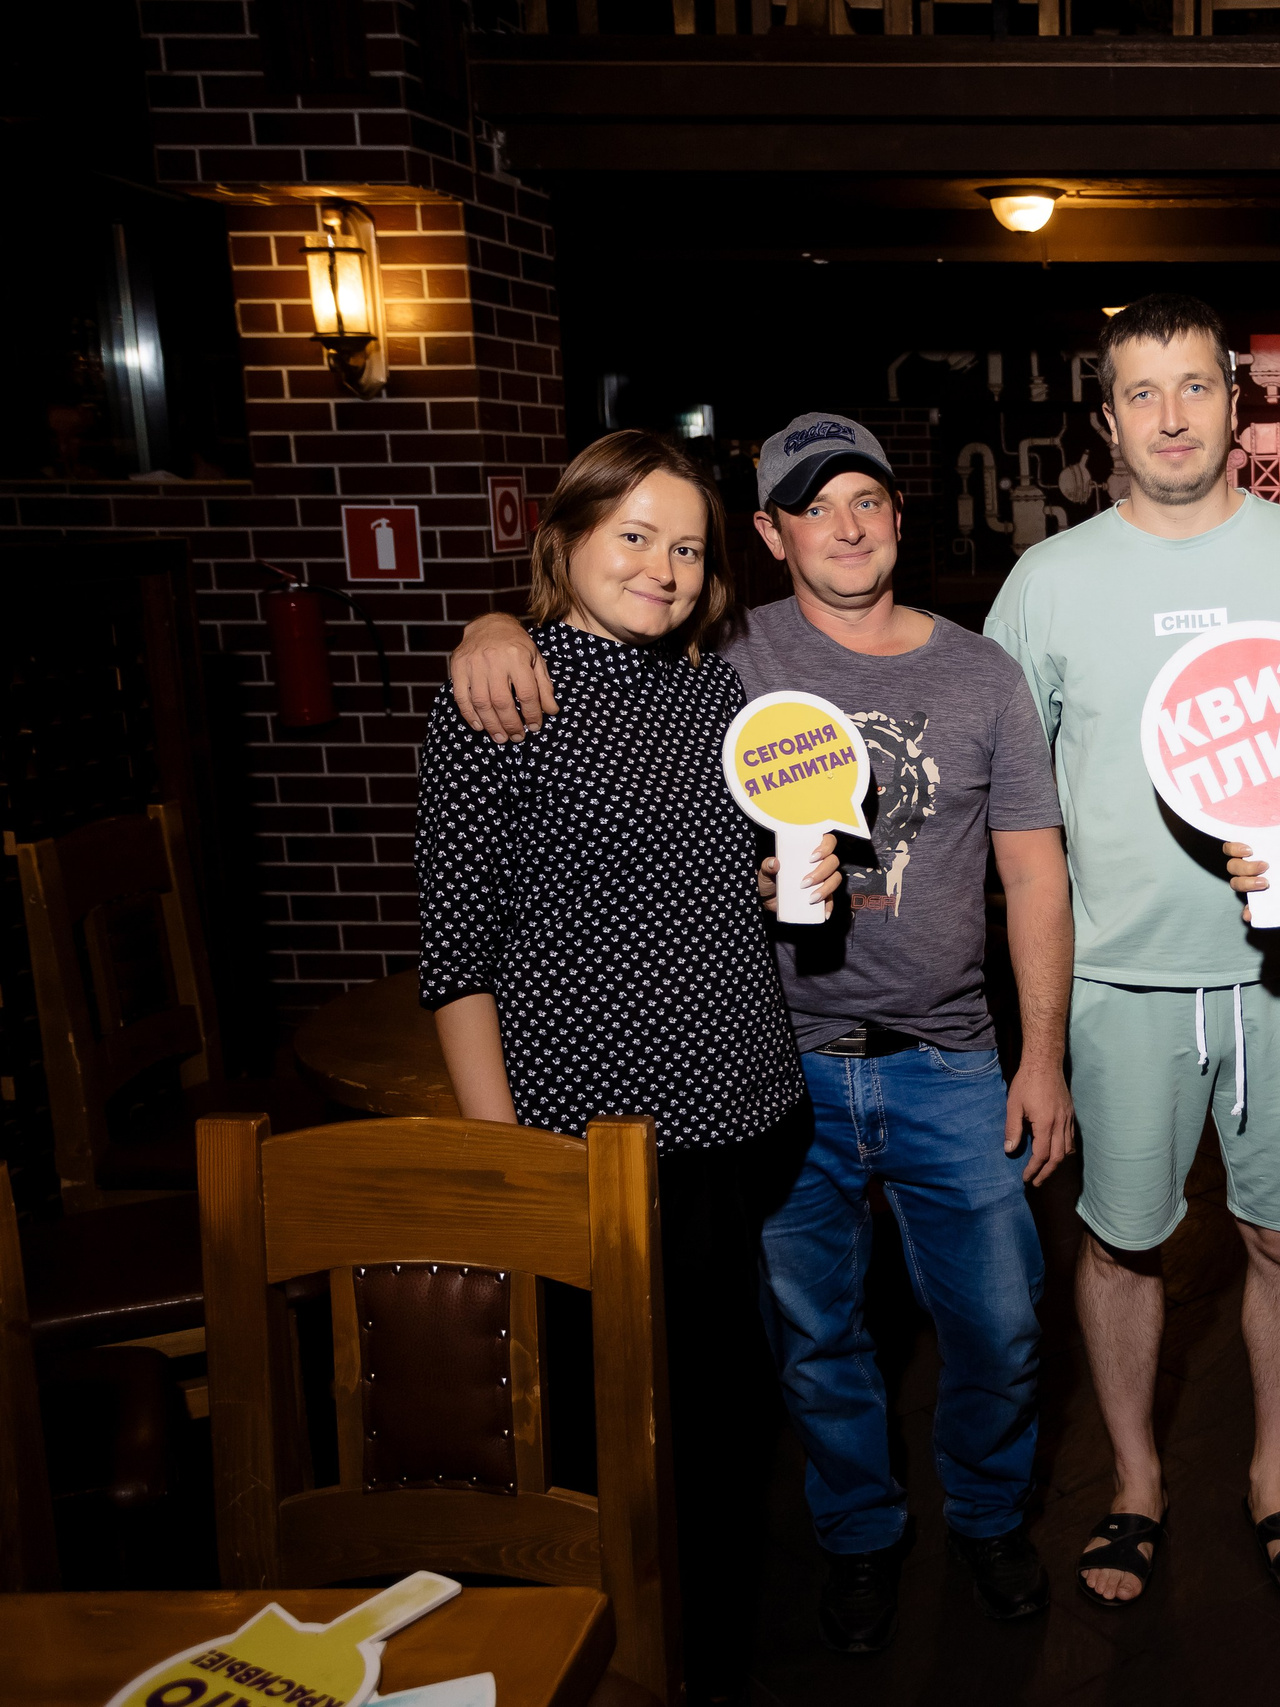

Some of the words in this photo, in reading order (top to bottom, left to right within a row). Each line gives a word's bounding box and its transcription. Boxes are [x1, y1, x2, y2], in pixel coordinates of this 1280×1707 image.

[1161, 613, 1221, 631] CHILL
[742, 723, 838, 767] СЕГОДНЯ
[744, 777, 761, 798] Я
[761, 745, 857, 792] КАПИТАН
